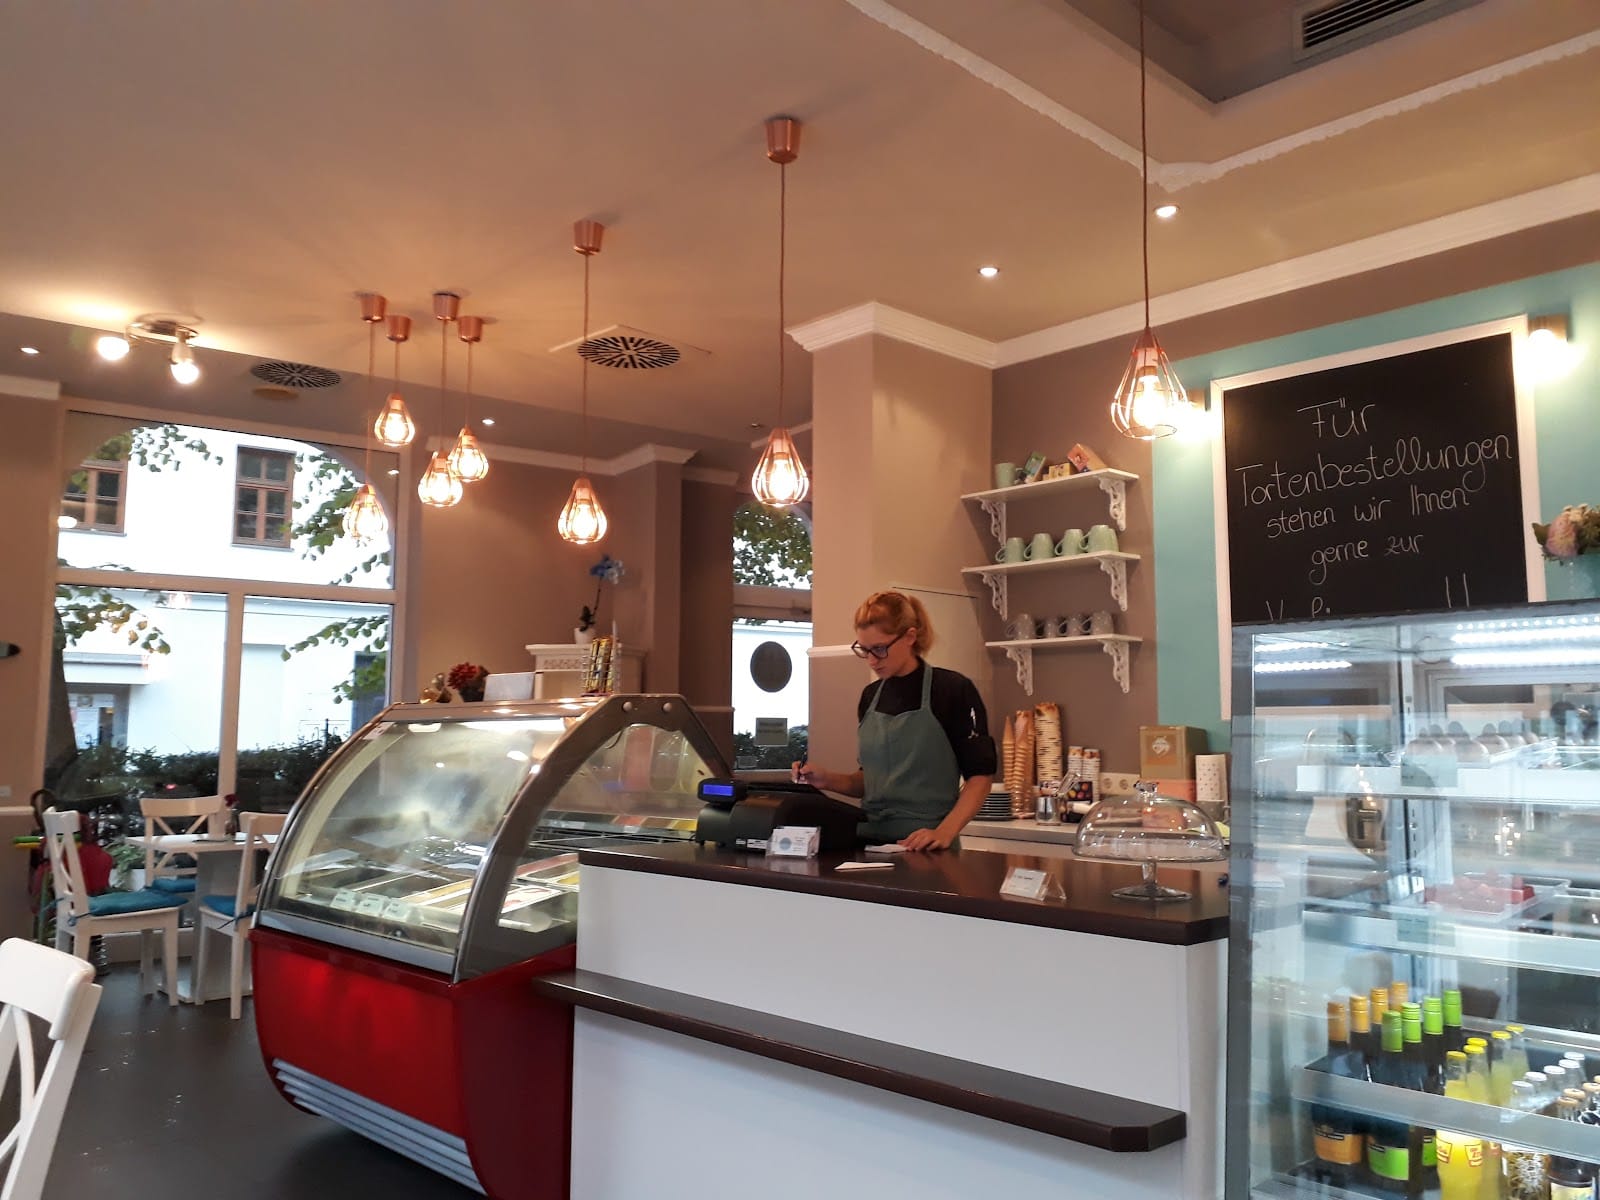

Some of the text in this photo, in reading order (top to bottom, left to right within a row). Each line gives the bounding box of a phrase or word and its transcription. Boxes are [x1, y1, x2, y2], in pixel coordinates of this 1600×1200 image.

[1297, 397, 1375, 438] Für
[1235, 434, 1512, 507] Tortenbestellungen
[1267, 484, 1470, 538] stehen wir Ihnen
[1309, 534, 1424, 586] gerne zur
